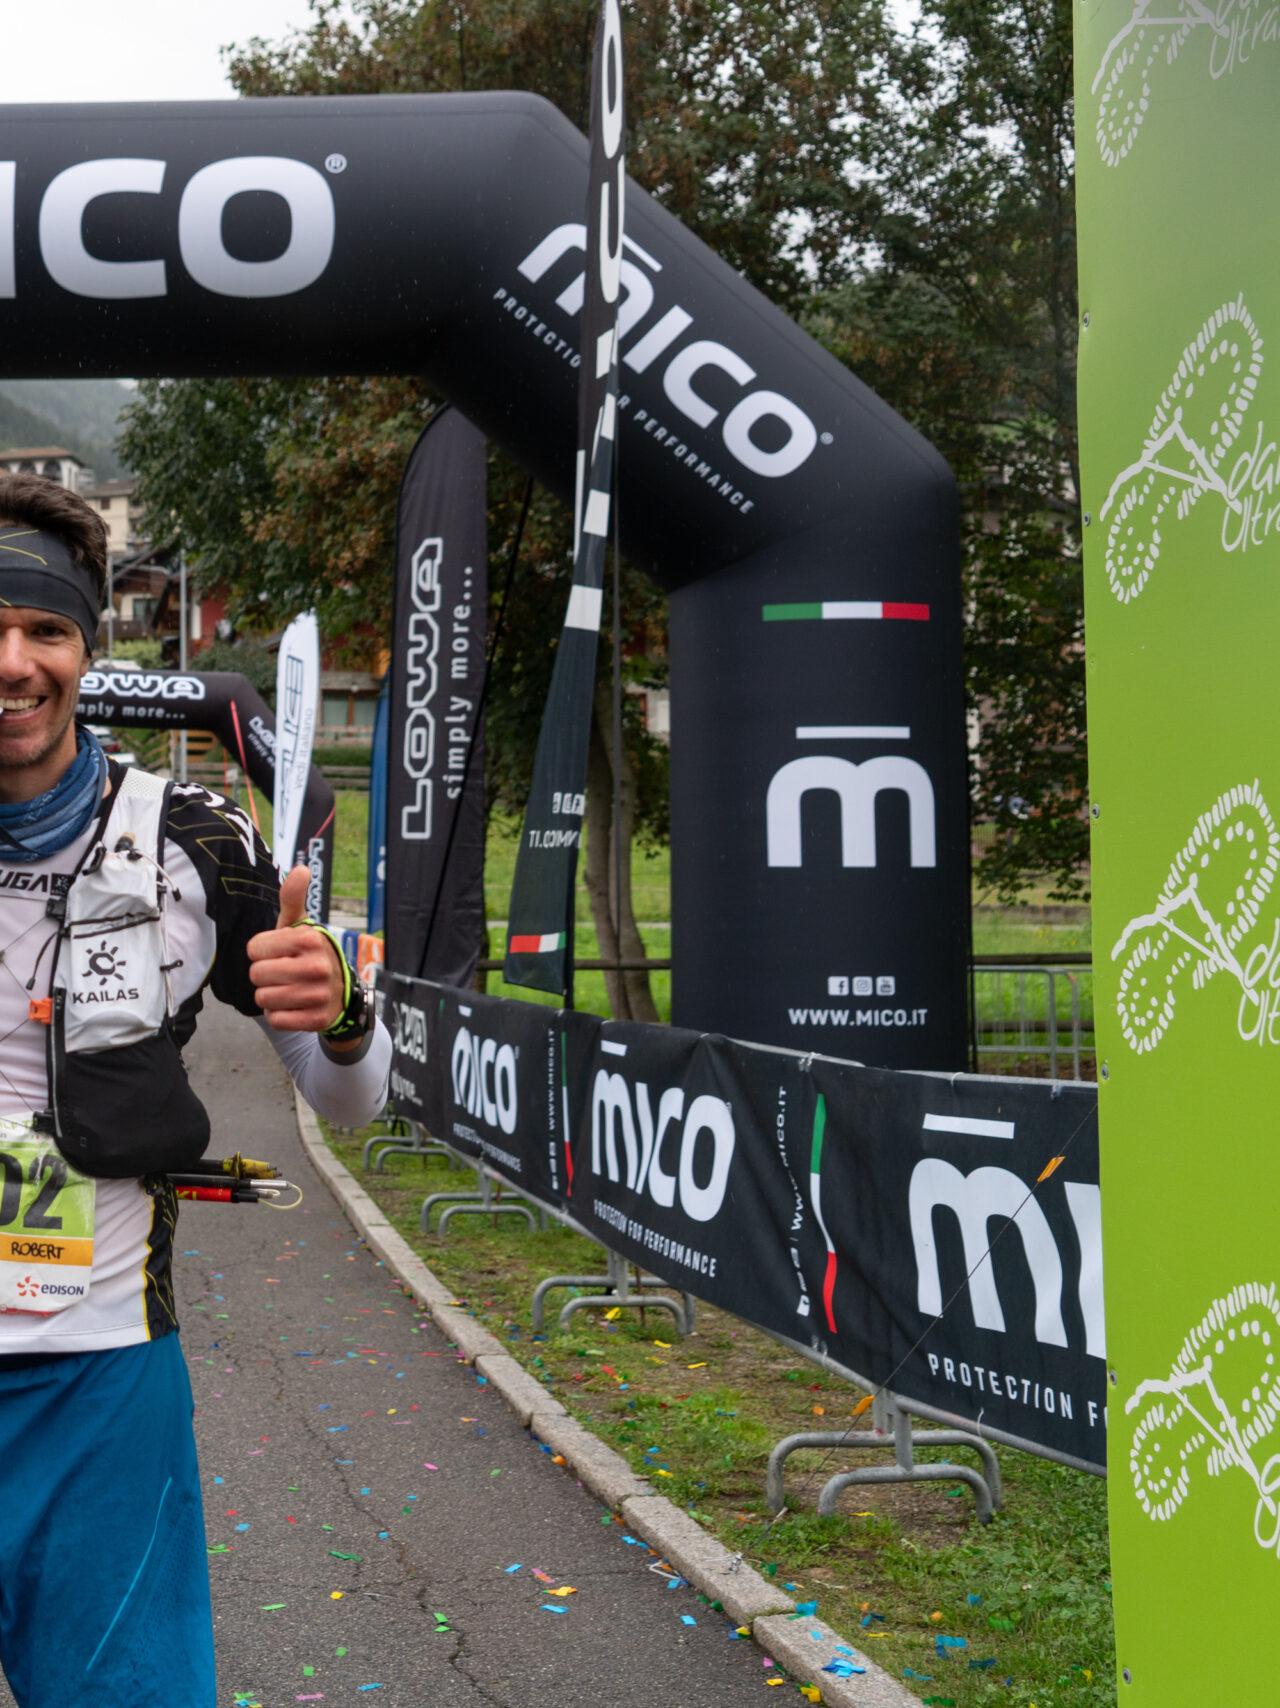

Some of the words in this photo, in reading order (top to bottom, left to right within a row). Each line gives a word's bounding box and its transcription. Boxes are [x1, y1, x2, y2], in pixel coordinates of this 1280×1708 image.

[493, 287, 582, 369] PROTECTIO
[633, 408, 756, 515] PERFORMANCE
[80, 671, 206, 701] OWA
[443, 695, 473, 799] simply
[72, 987, 140, 1005] KAILAS
[787, 1007, 929, 1028] WWW.MICO.IT
[10, 1242, 66, 1261] ROBERT
[627, 1219, 644, 1243] FOR
[642, 1227, 718, 1279] PERFORMANCE
[927, 1351, 1074, 1421] PROTECTION
